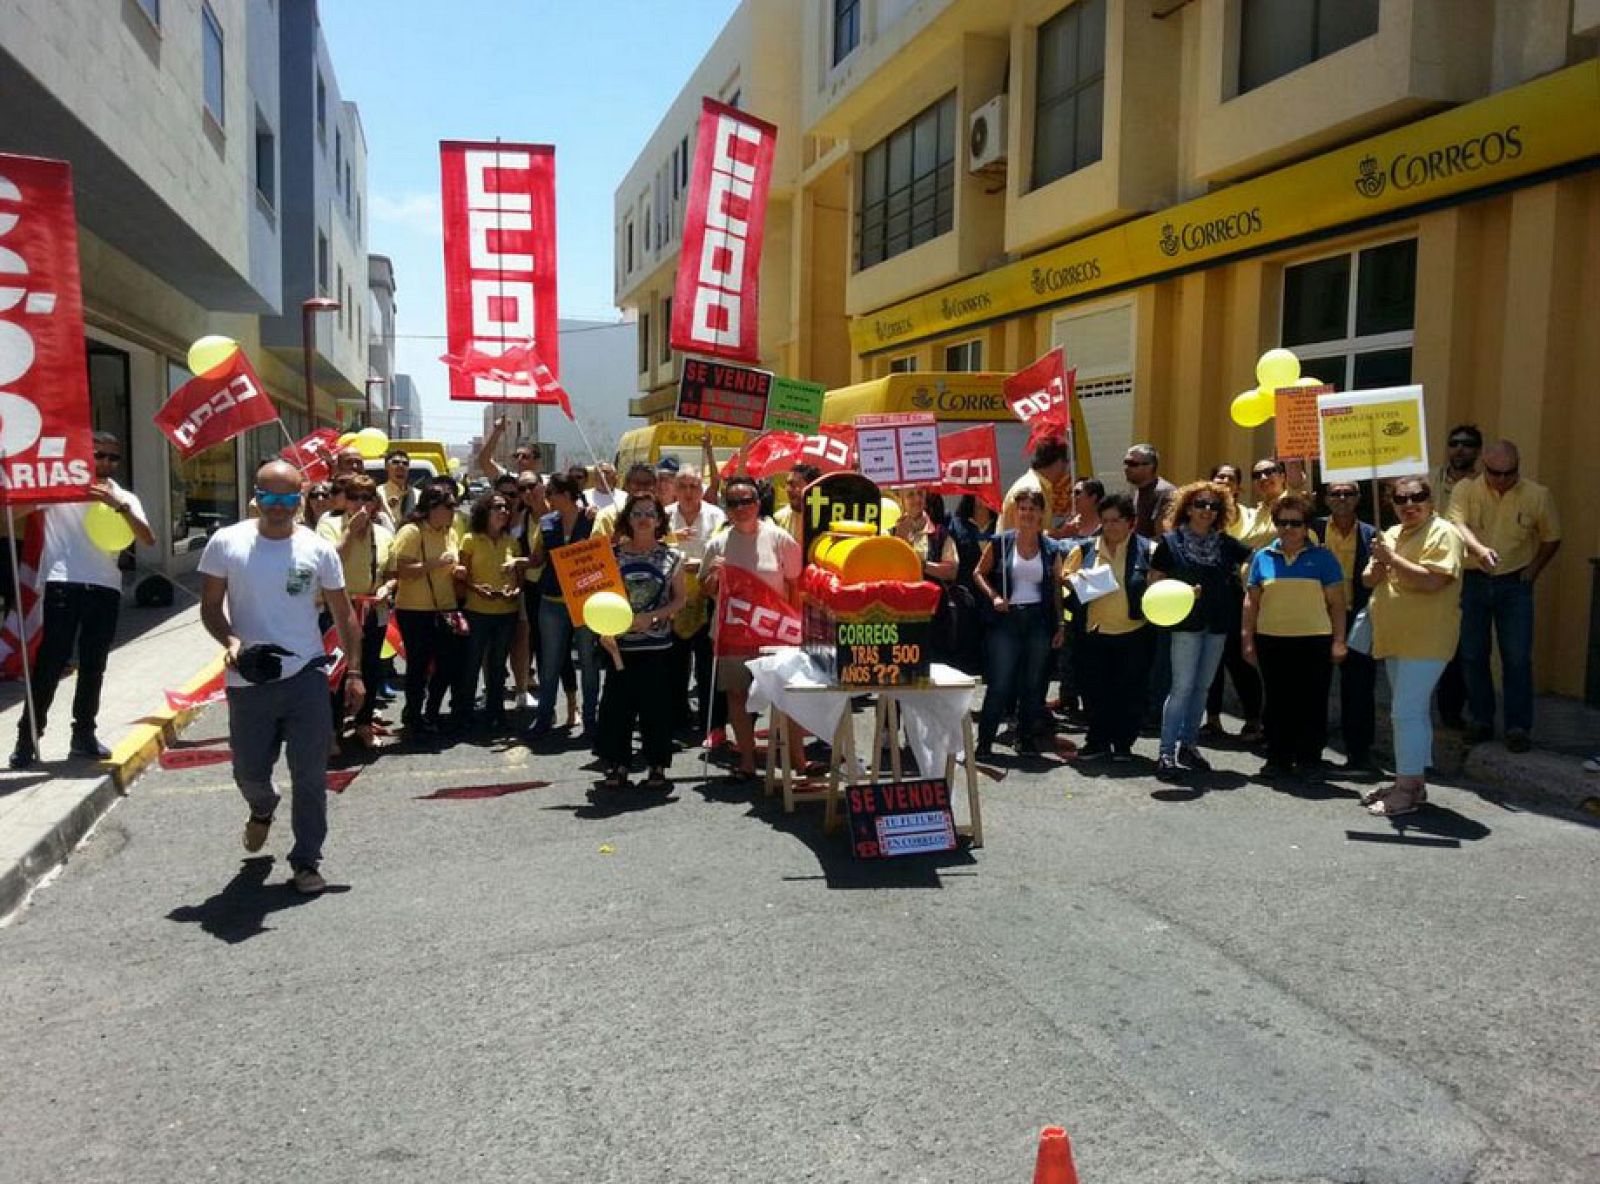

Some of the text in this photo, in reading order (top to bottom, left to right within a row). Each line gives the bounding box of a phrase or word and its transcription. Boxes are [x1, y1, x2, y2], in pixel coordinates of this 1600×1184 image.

[1390, 125, 1523, 190] CORREOS
[691, 113, 761, 347] CCOO
[1182, 207, 1262, 251] CORREOS
[1046, 260, 1101, 292] CORREOS
[686, 362, 709, 383] SE
[714, 366, 768, 392] VENDE
[937, 391, 1007, 412] CORRE
[838, 624, 899, 645] CORREOS
[851, 645, 920, 665] TRAS 500
[851, 783, 946, 813] SE VENDE
